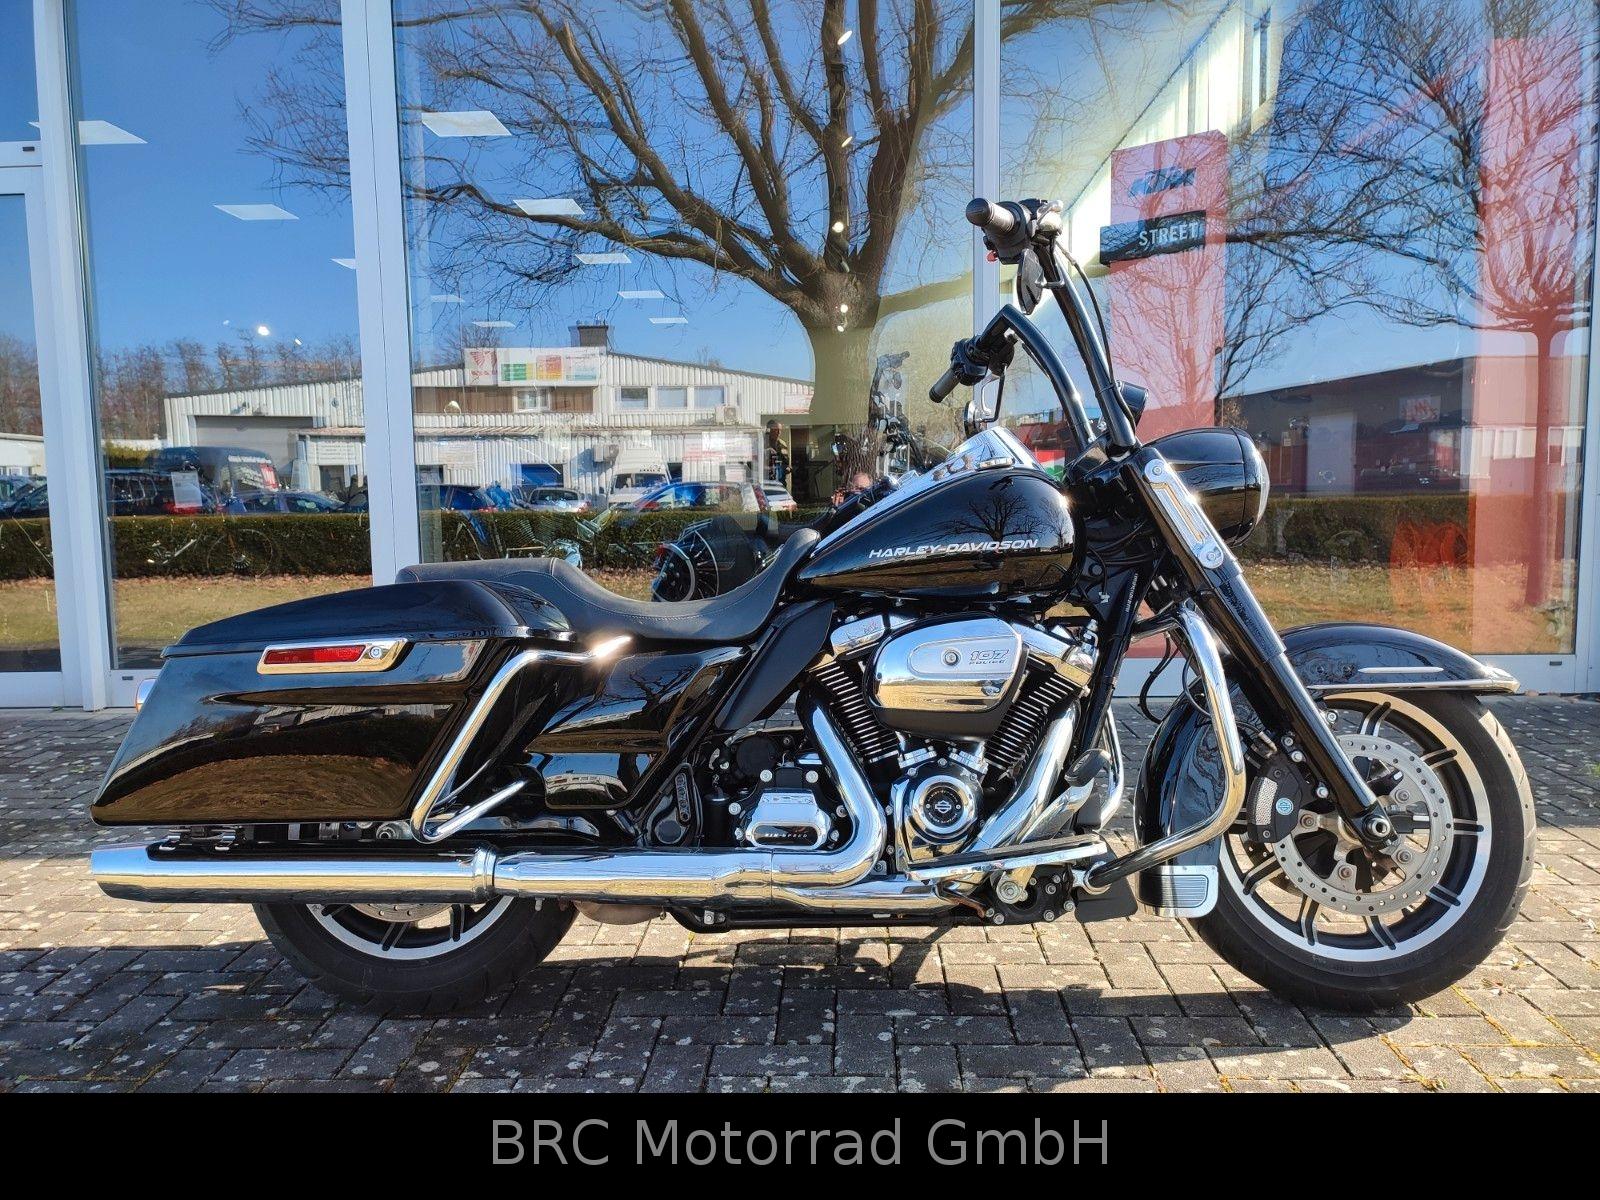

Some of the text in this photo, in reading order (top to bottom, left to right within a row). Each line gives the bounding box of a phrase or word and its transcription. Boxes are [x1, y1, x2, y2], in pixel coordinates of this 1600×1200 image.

[1138, 221, 1198, 246] STREET
[868, 538, 1039, 559] HARLEY-DAVIDSON
[970, 649, 1010, 661] 107
